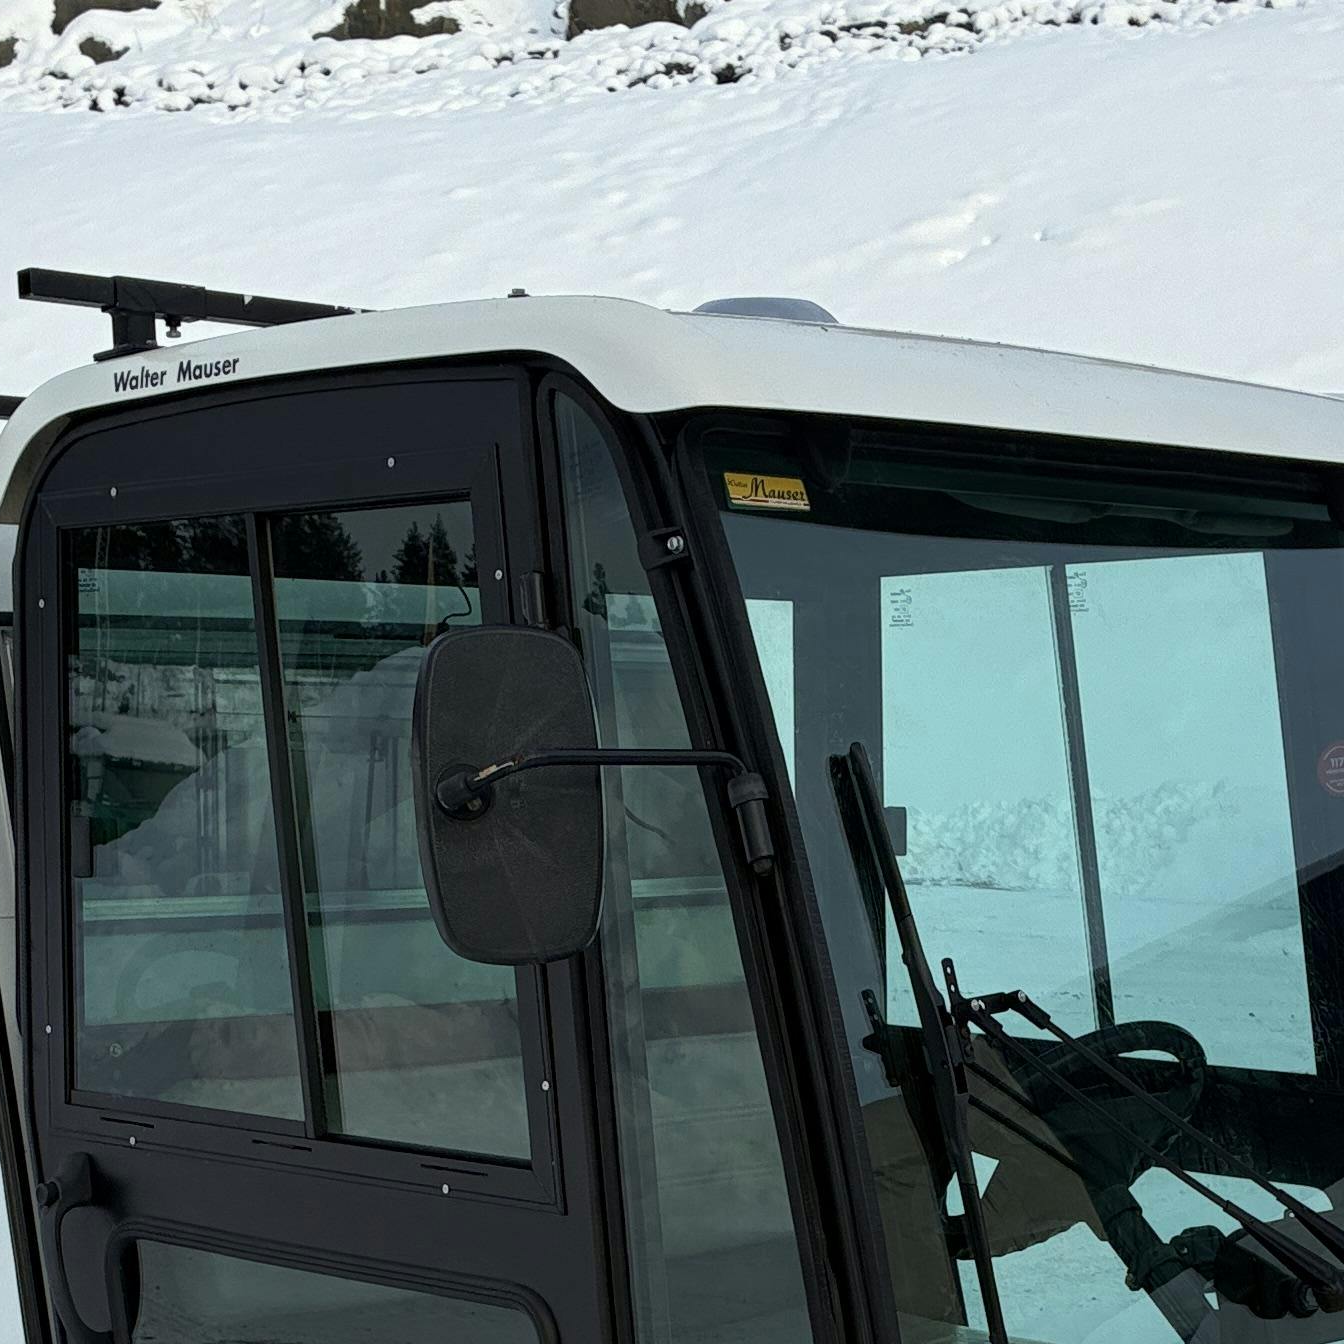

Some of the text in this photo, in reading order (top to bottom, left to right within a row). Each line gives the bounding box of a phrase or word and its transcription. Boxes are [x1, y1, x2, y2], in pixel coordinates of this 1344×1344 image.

[113, 357, 239, 392] Walter Mauser
[742, 477, 805, 501] Mauser
